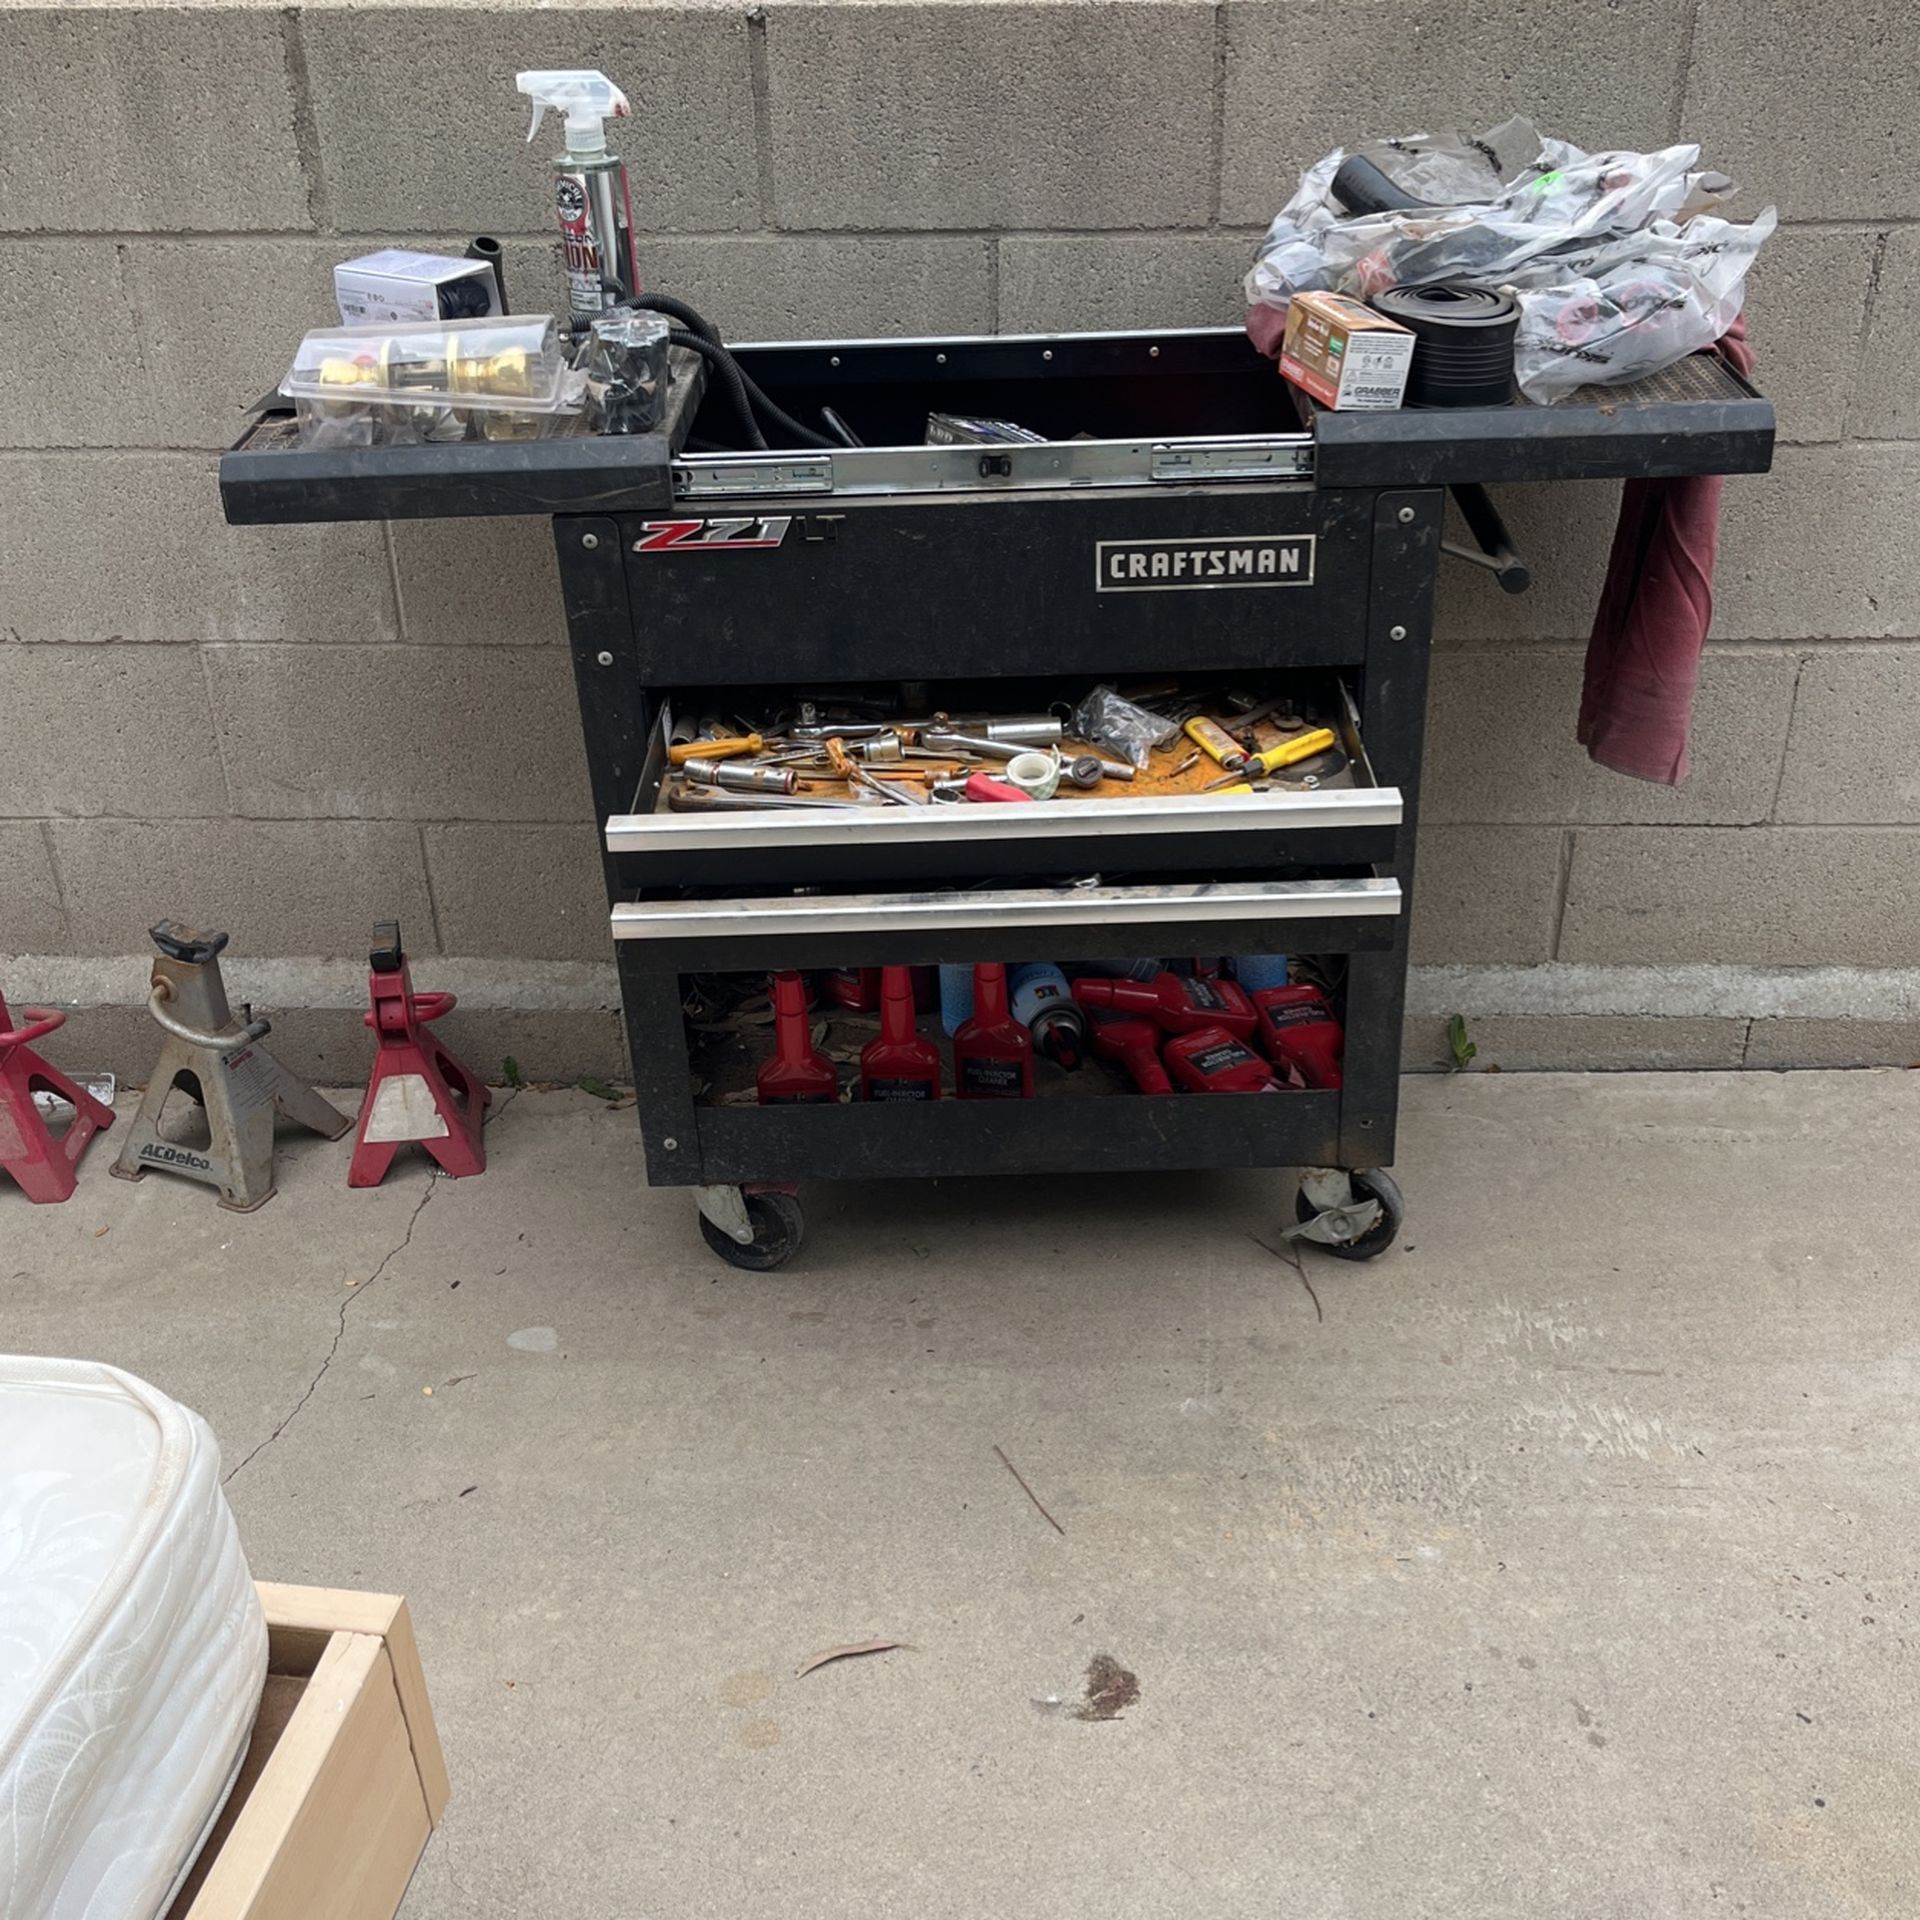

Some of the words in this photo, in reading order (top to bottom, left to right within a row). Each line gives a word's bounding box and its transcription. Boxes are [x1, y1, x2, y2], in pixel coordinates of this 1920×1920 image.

[1354, 387, 1401, 399] GRABBER
[632, 516, 792, 551] Z71
[1110, 548, 1299, 579] CRAFTSMAN
[141, 1144, 210, 1170] ACDelco
